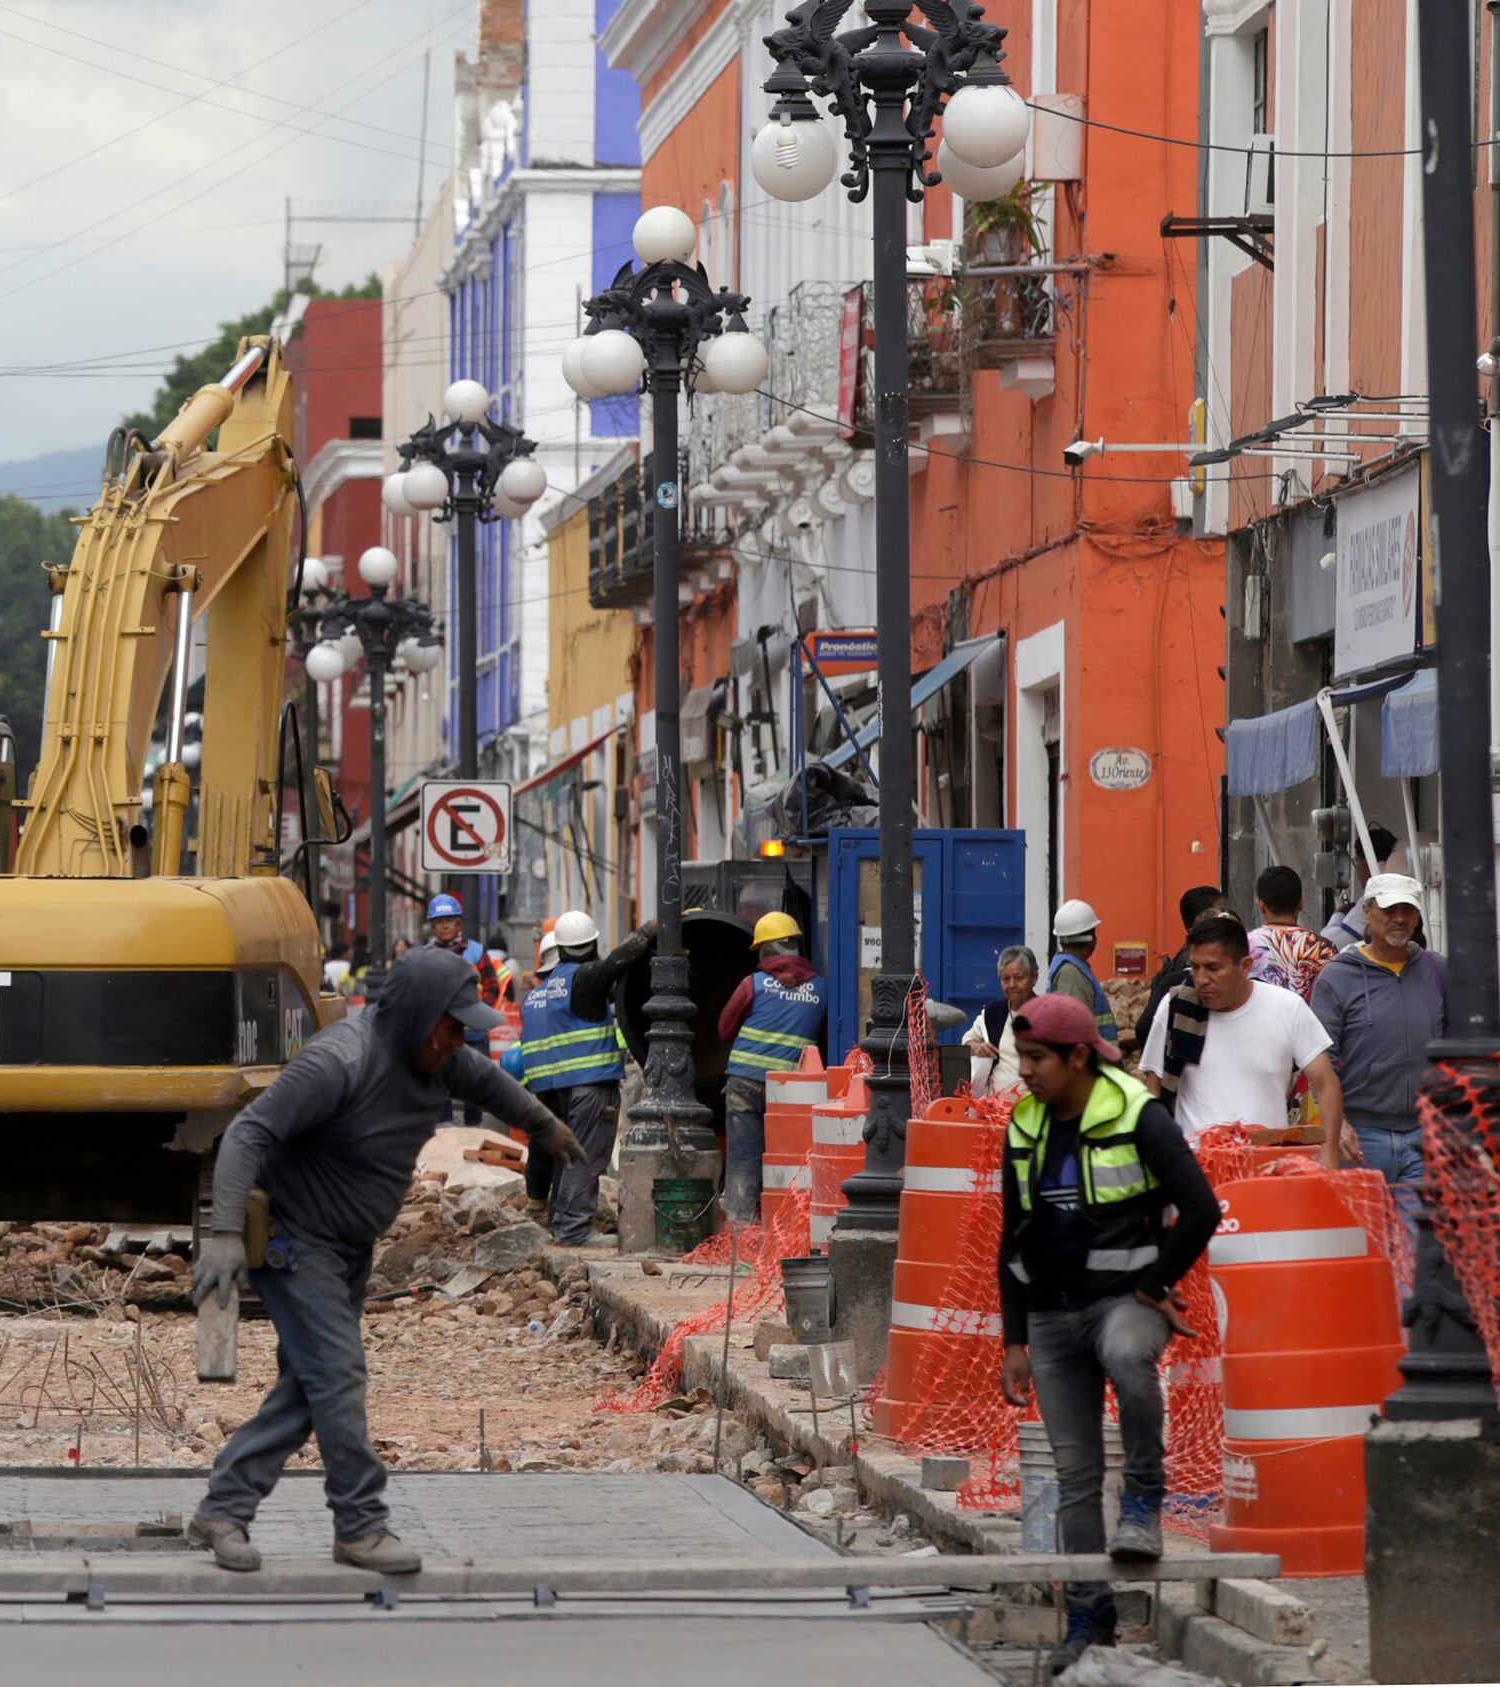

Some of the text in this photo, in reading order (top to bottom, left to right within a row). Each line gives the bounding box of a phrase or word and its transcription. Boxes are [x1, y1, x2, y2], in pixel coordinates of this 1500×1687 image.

[821, 642, 878, 652] Pronóstic
[1102, 766, 1144, 779] 13 Oriente
[450, 805, 484, 851] E
[779, 988, 820, 1004] rumbo
